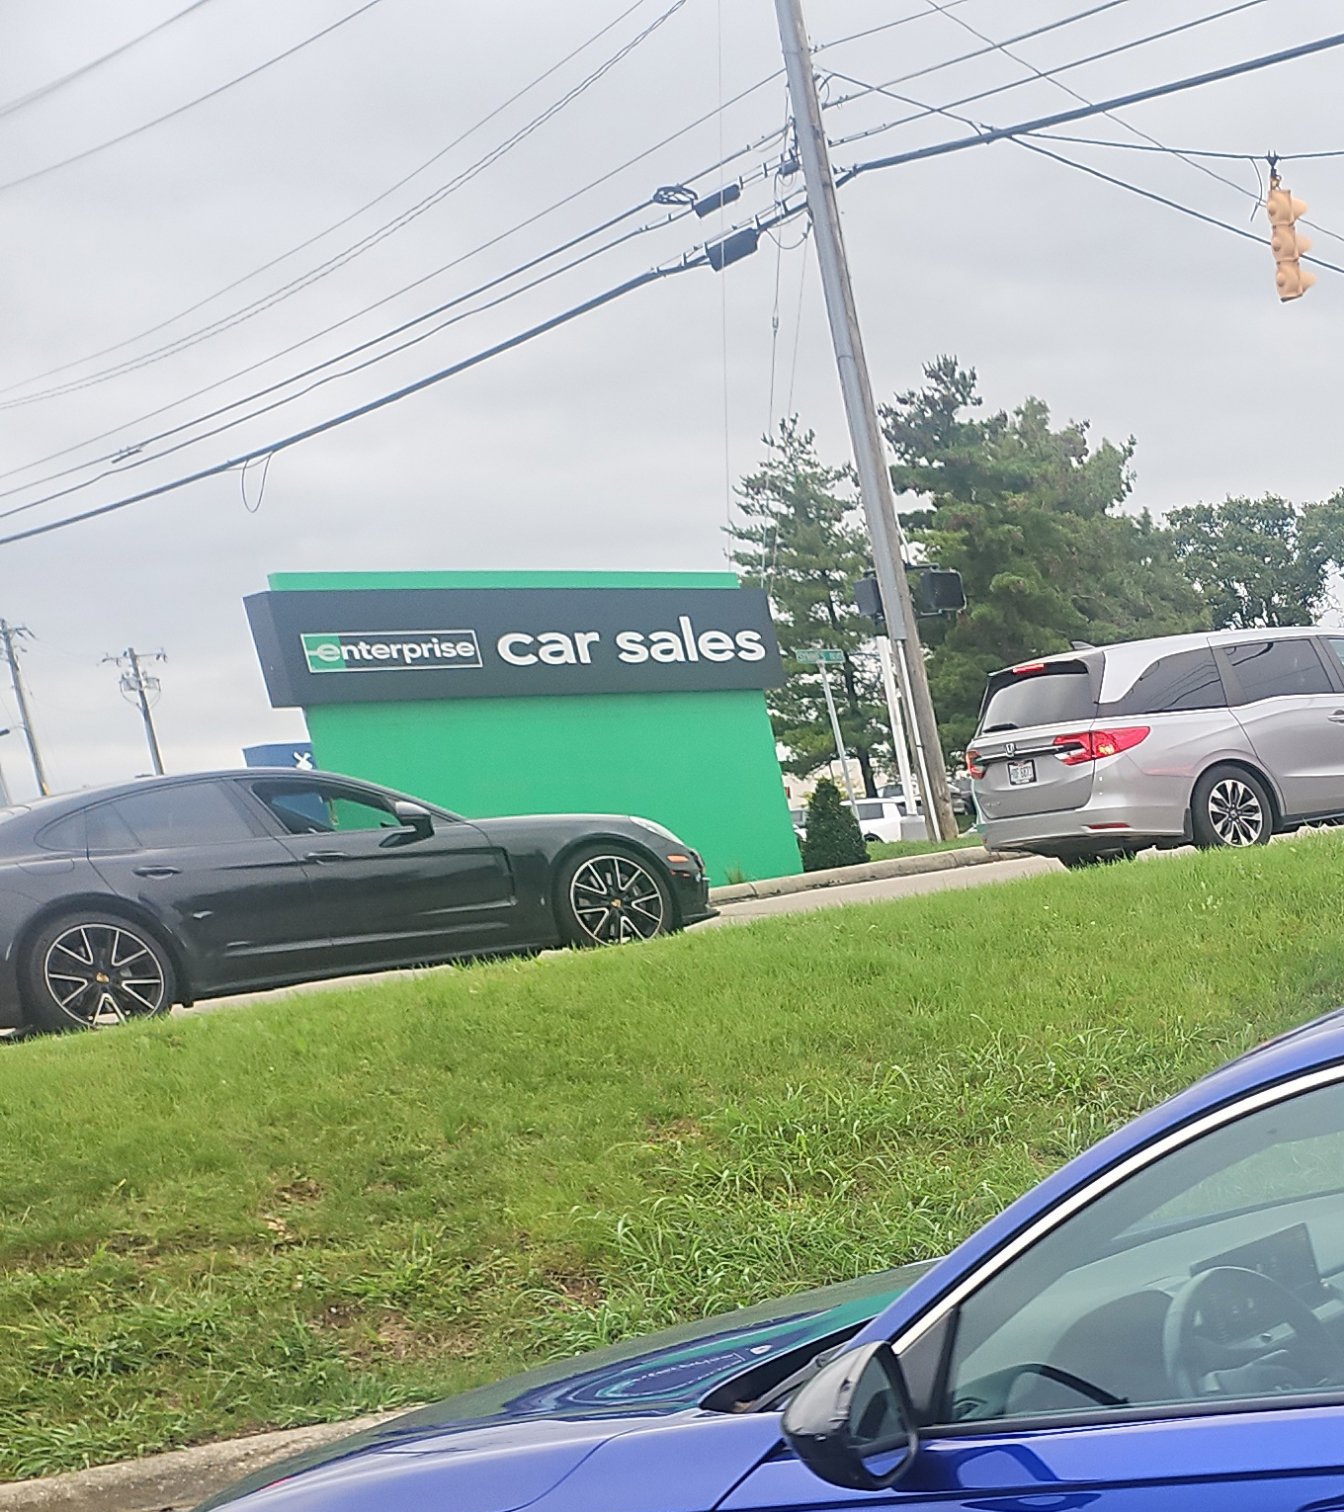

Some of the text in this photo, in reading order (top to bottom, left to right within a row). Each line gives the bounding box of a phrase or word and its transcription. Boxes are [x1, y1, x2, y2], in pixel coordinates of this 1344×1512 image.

[315, 616, 766, 665] enterprise car sales
